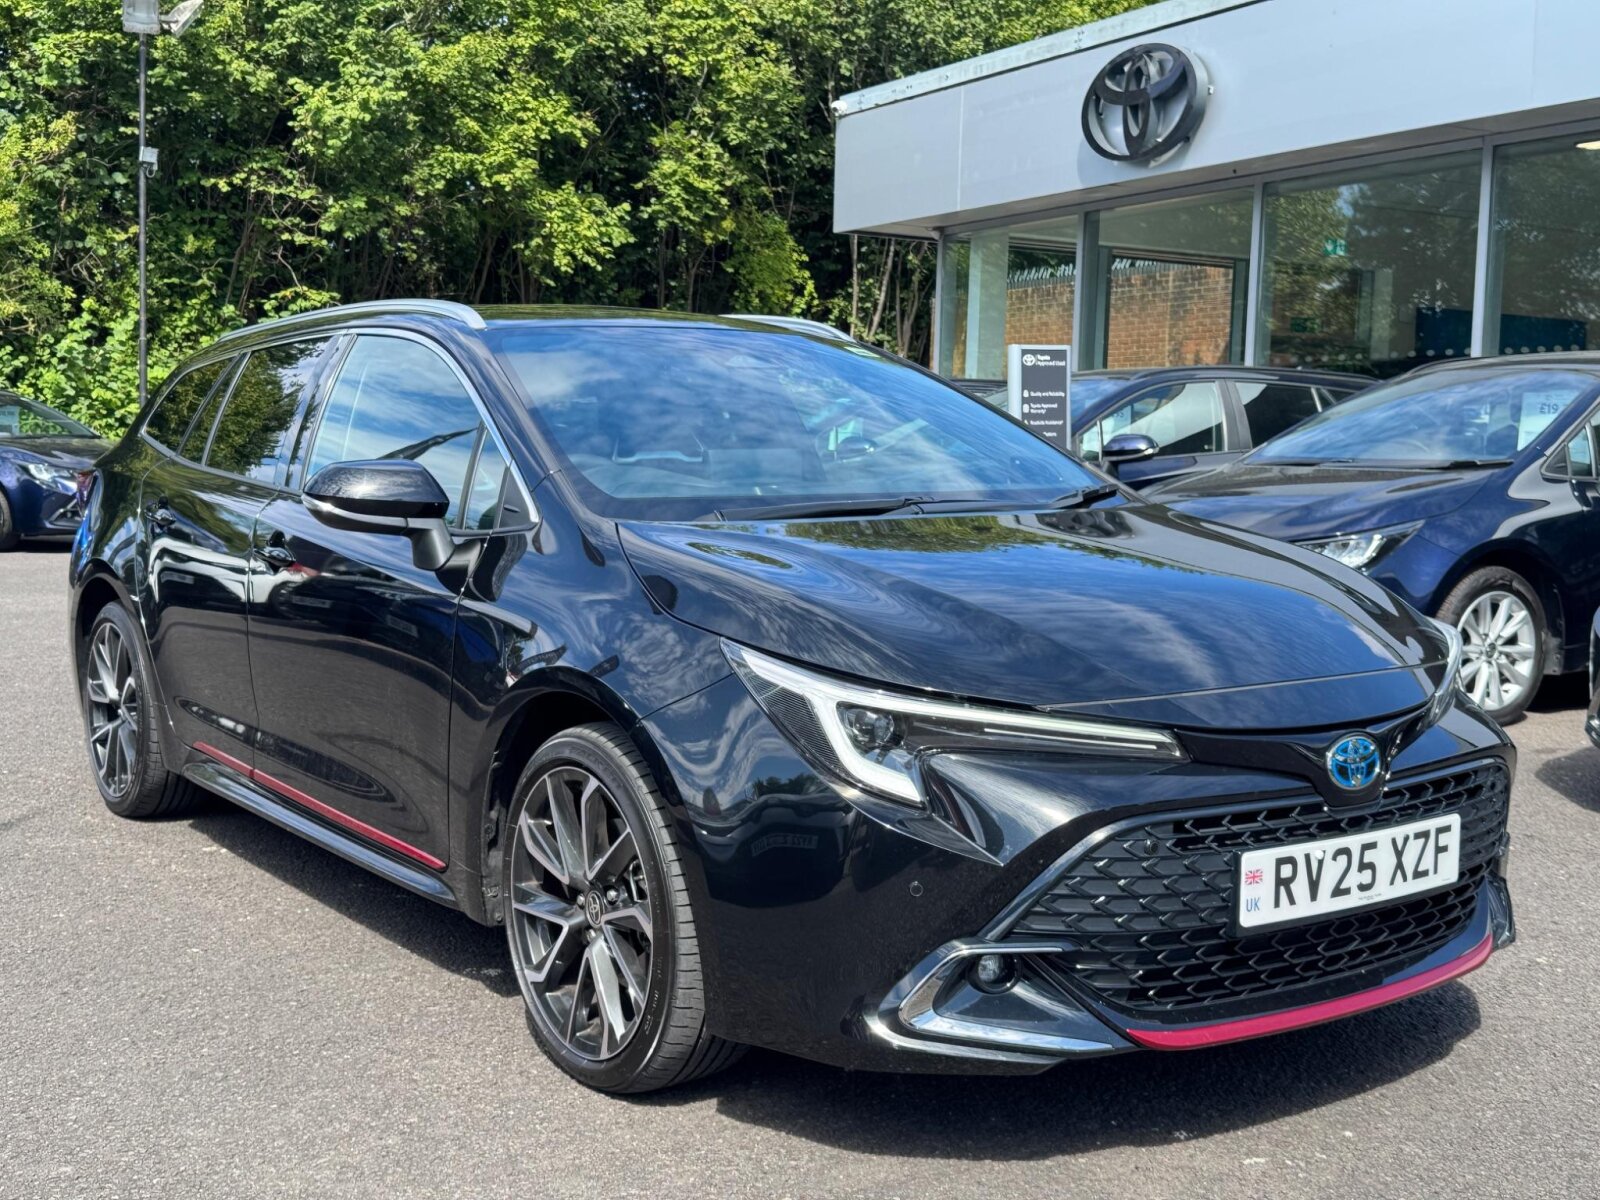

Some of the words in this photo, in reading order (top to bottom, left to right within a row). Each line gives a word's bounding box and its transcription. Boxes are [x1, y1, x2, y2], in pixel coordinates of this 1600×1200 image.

[1274, 840, 1379, 909] RV25
[1389, 824, 1452, 886] XZF
[1245, 896, 1261, 913] UK
